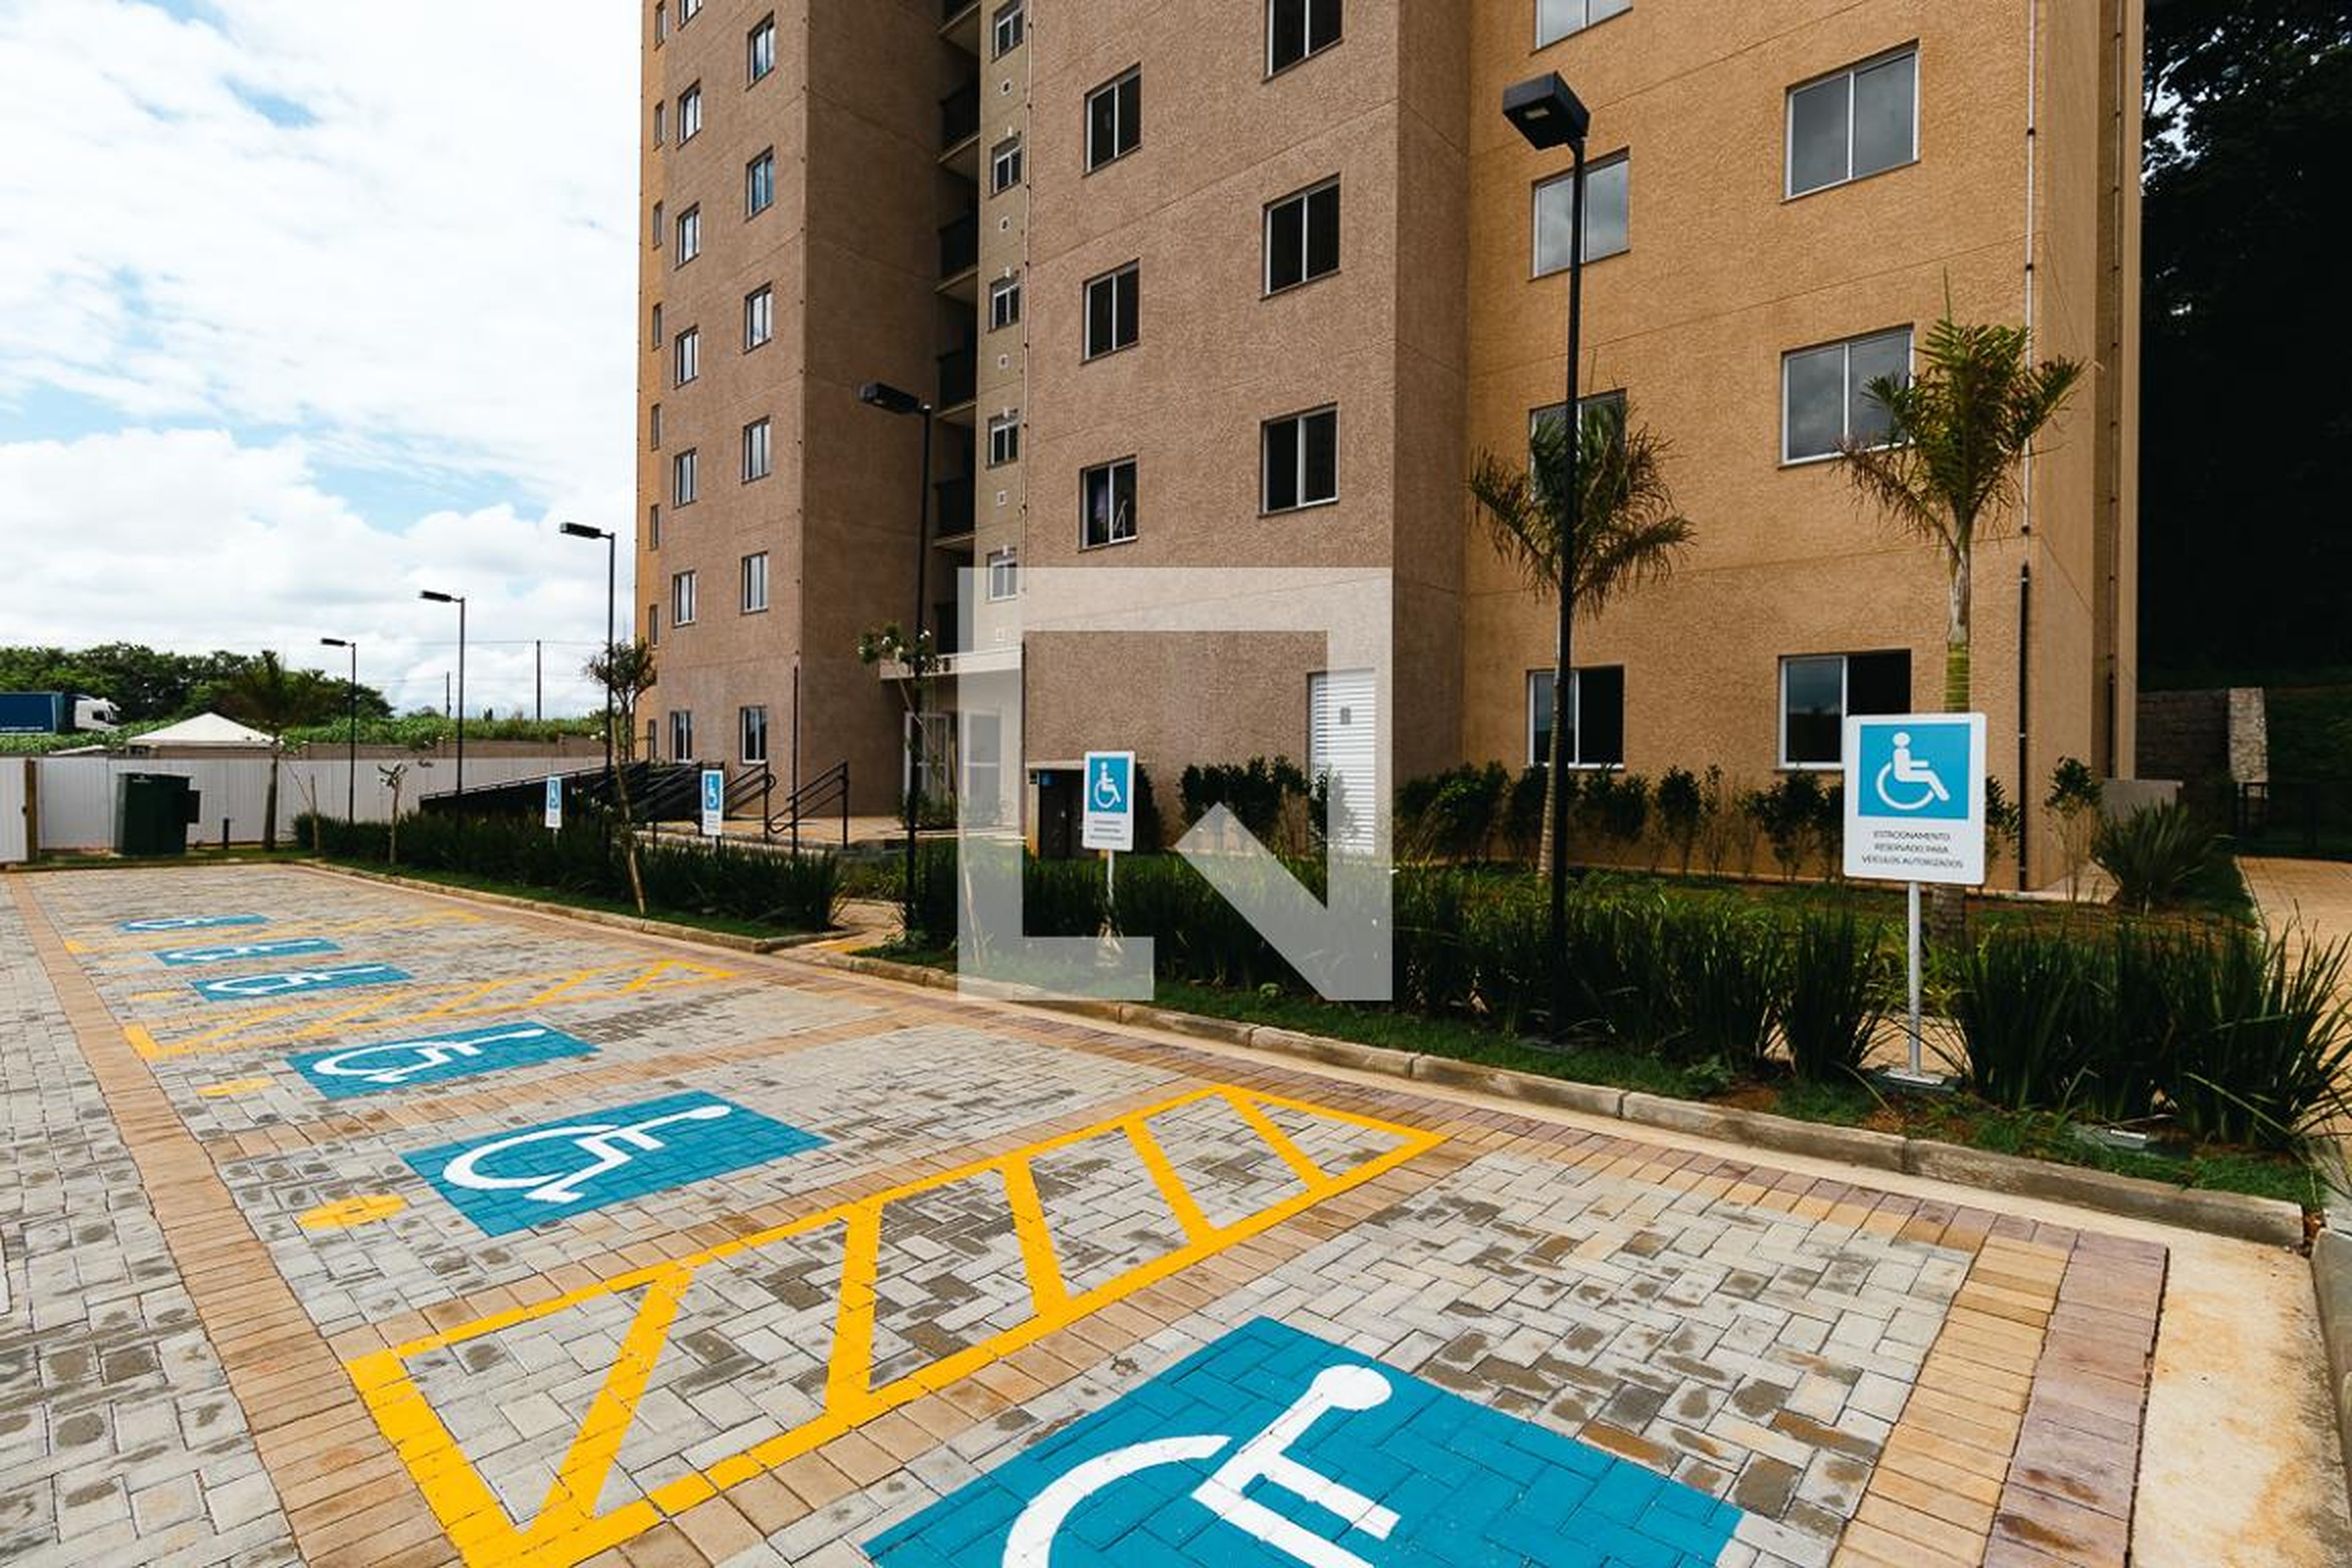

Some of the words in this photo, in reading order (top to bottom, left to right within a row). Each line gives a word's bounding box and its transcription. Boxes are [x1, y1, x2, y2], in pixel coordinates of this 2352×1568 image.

[1874, 830, 1950, 840] ESTACIONAMENTO
[1874, 843, 1924, 852] RESERVADO
[1926, 845, 1948, 853] PARA
[1902, 857, 1964, 869] AUTORIZADOS
